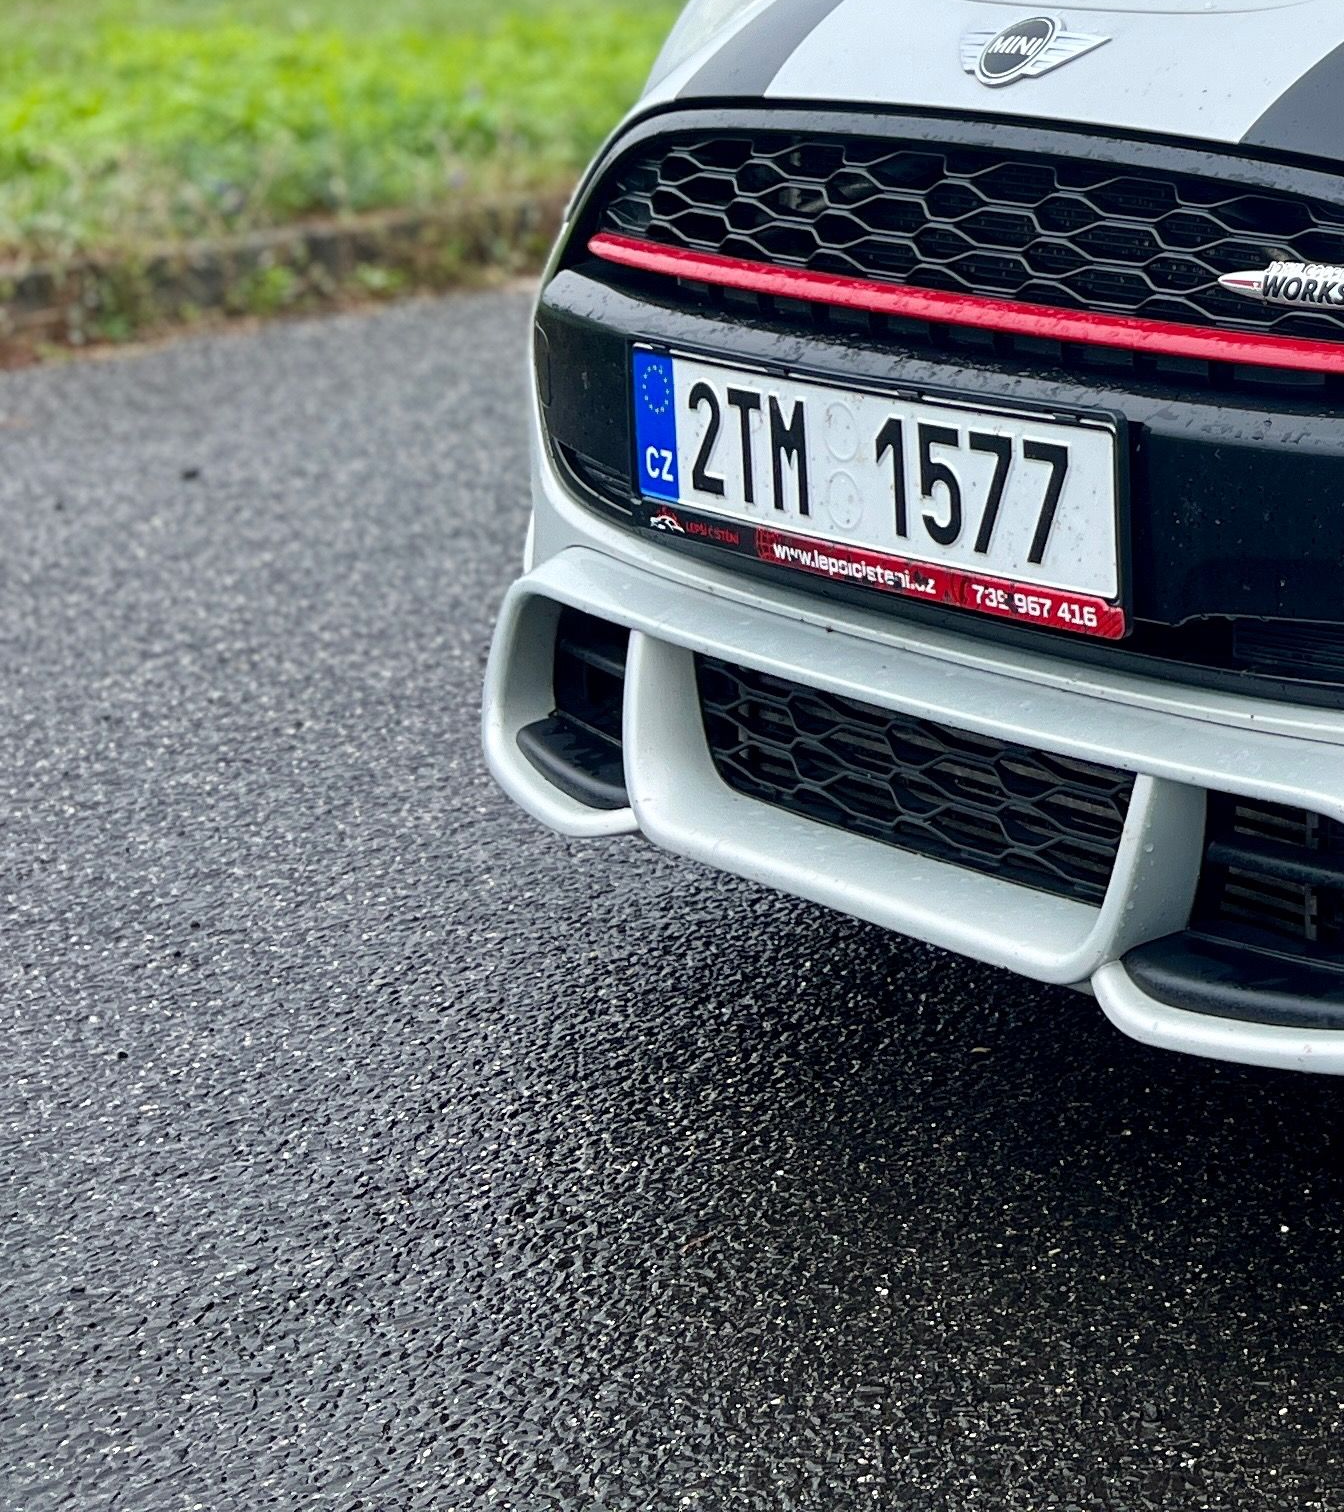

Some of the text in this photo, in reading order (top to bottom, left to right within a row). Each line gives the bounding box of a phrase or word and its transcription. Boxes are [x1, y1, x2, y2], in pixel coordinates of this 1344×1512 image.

[987, 35, 1045, 56] MINI
[645, 446, 674, 483] CZ
[688, 379, 1069, 565] 2TM 1577
[1013, 593, 1052, 618] 967
[1057, 602, 1098, 628] 416
